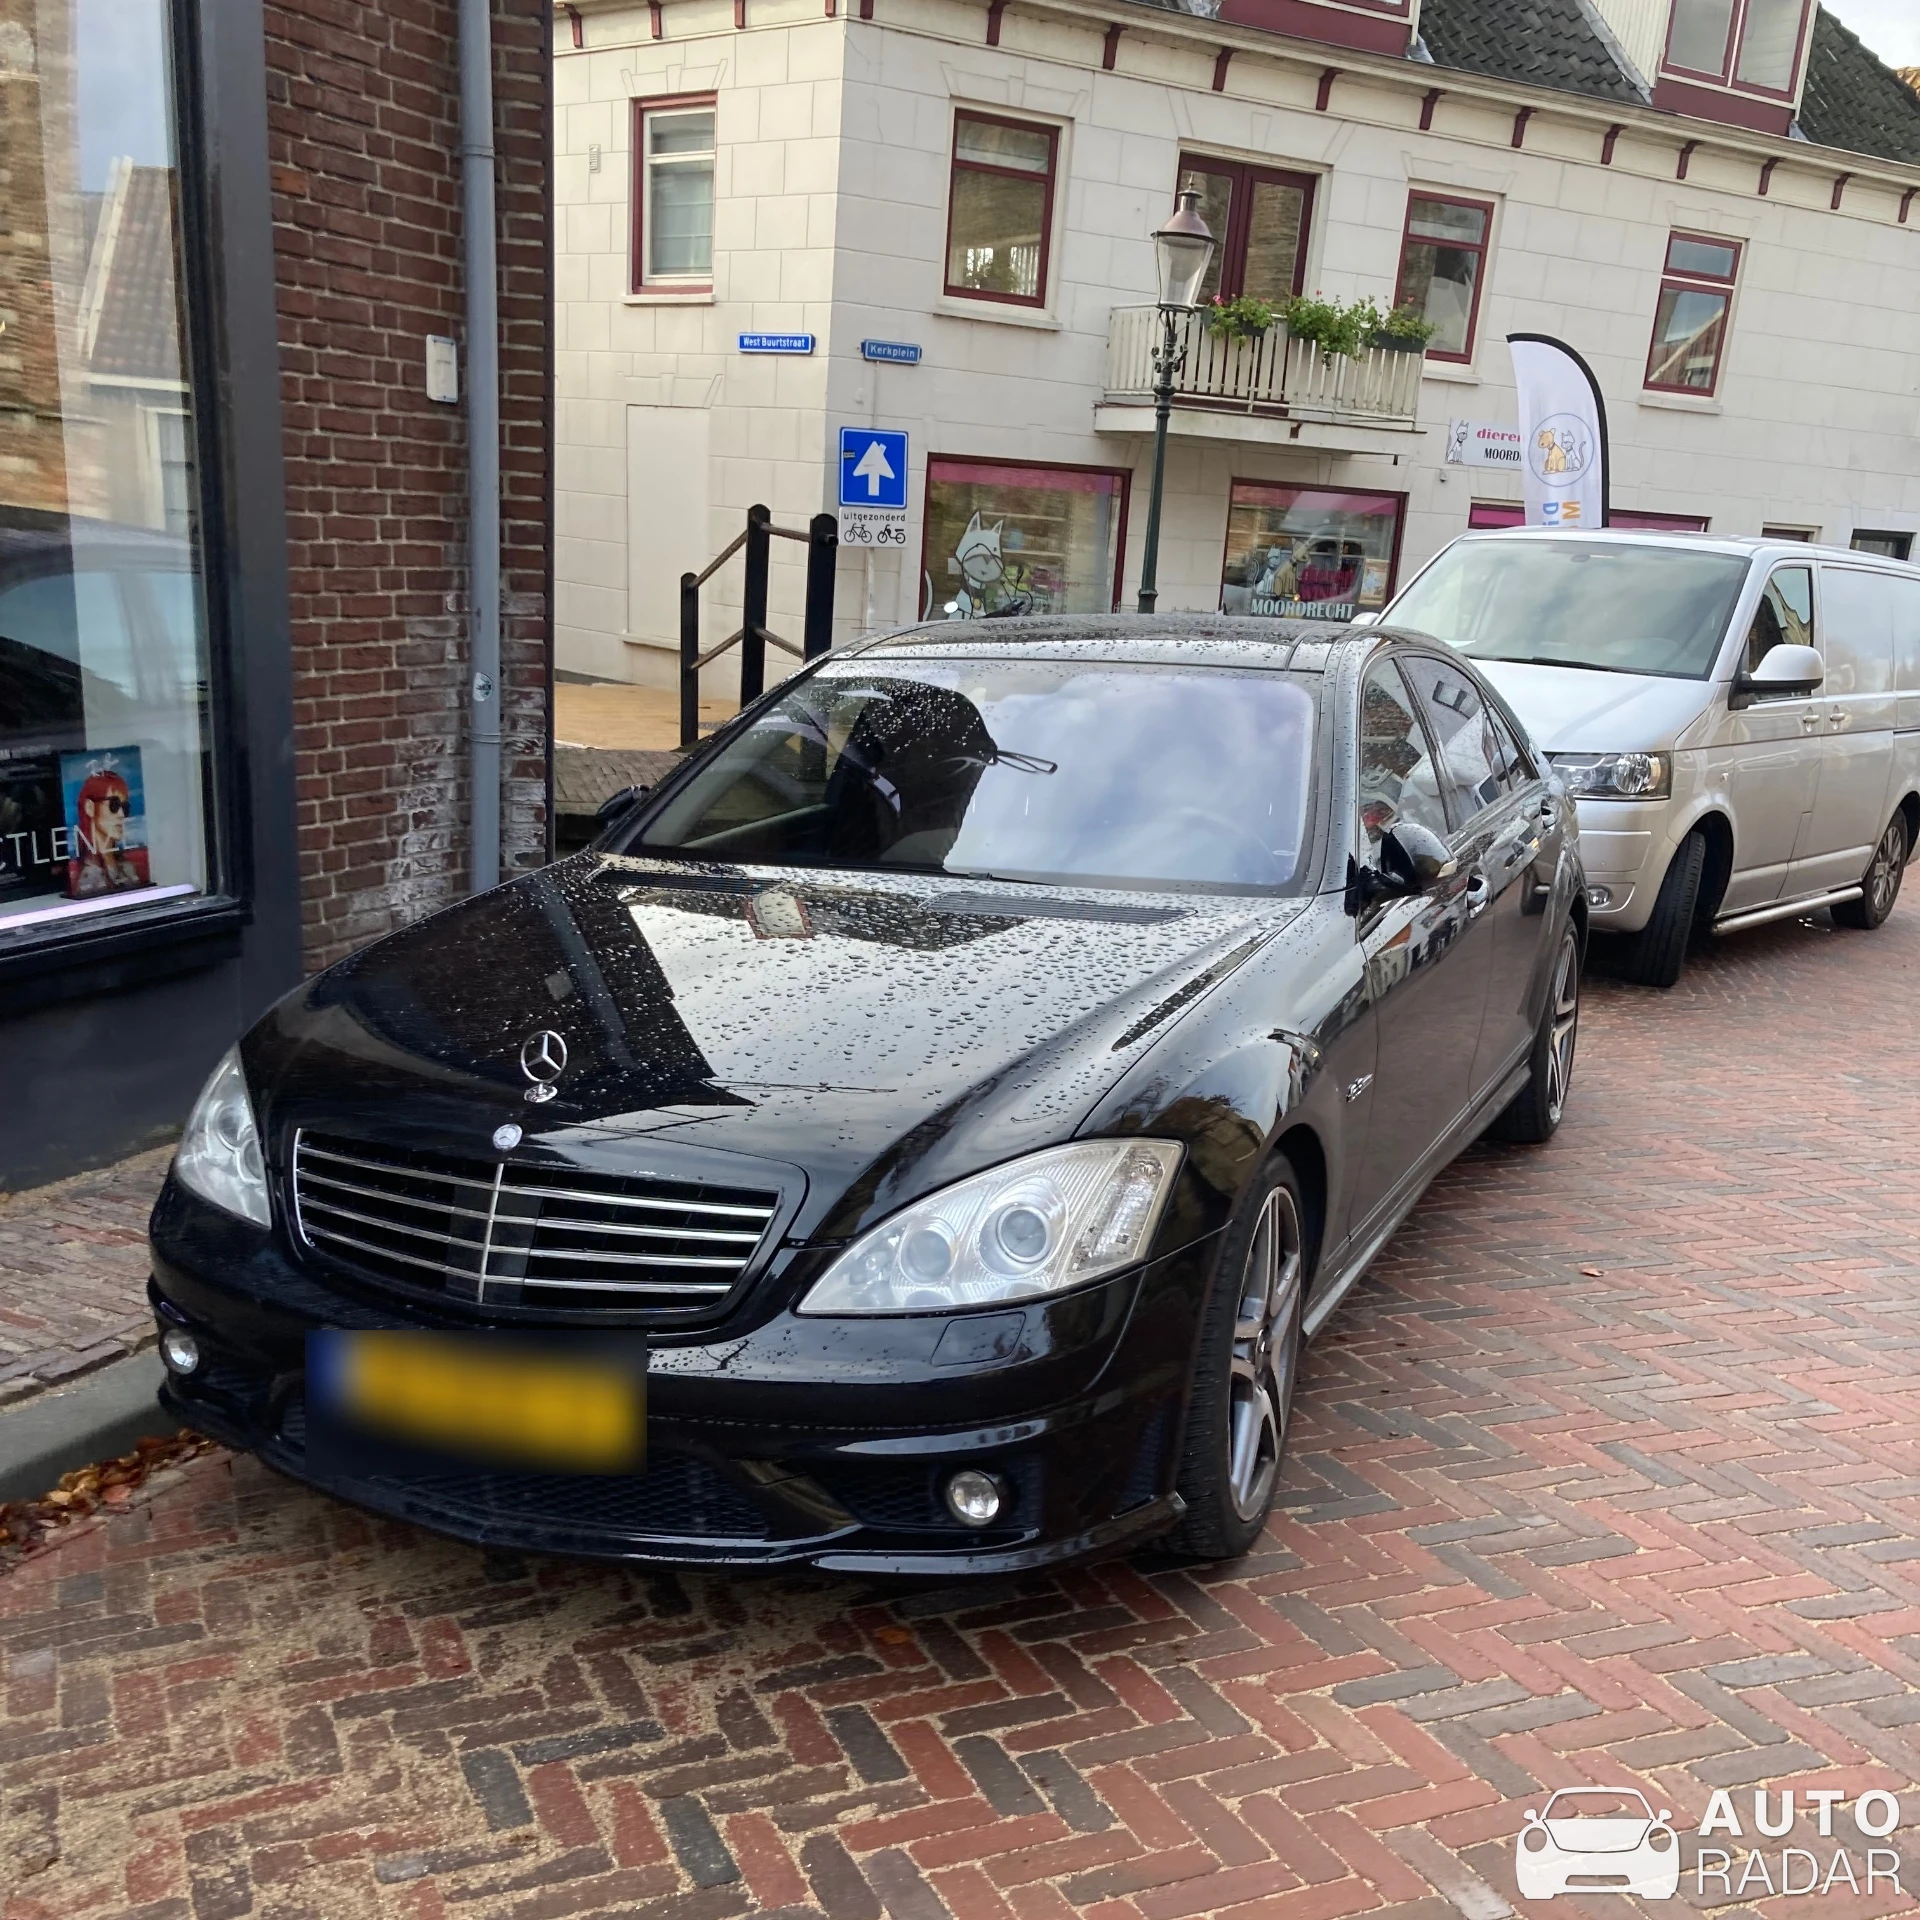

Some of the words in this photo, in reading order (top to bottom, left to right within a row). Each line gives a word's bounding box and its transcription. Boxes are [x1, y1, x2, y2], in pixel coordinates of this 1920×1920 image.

[743, 336, 760, 347] West
[761, 337, 806, 348] Buurtstraat
[870, 344, 915, 358] Kerkplein
[1484, 447, 1521, 462] MOORD
[844, 512, 906, 522] uitgezonderd
[1251, 598, 1355, 619] MOORDRECHT
